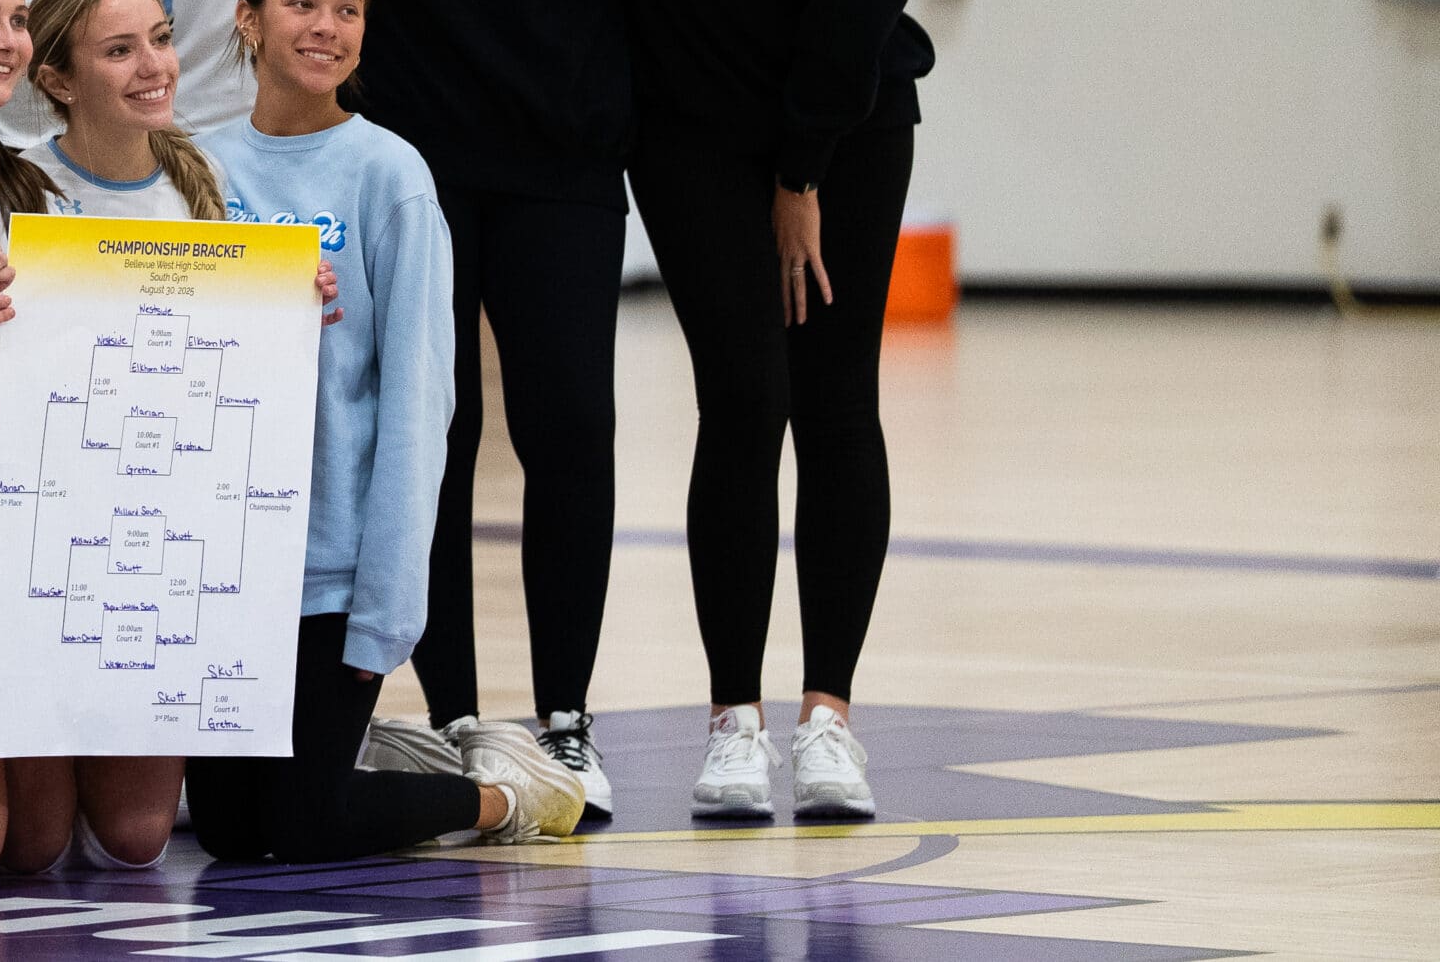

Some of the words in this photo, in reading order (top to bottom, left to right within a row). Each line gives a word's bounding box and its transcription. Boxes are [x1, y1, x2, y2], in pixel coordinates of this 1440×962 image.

[98, 240, 190, 257] CHAMPIONSHIP
[192, 243, 246, 258] BRACKET
[124, 259, 155, 269] Bellevue
[156, 260, 174, 270] West
[175, 260, 192, 272] High
[193, 261, 217, 271] School
[150, 273, 171, 282] South
[171, 273, 189, 284] Gym
[140, 285, 165, 296] August
[178, 287, 195, 296] 2025
[139, 304, 173, 316] Westside
[148, 339, 164, 347] Court
[189, 380, 206, 388] 12:00
[188, 390, 204, 398] Court
[130, 405, 165, 418] Marian
[137, 431, 162, 439] 10:00am
[135, 441, 154, 449] Court
[154, 441, 160, 449] #1
[126, 464, 158, 477] Gretna
[249, 503, 291, 513] Championship
[70, 594, 86, 602] Court
[168, 589, 185, 597] Court
[207, 659, 243, 678] Skutt
[157, 690, 187, 704] Skutt
[215, 695, 228, 703] 1:00
[208, 718, 242, 731] Gretna
